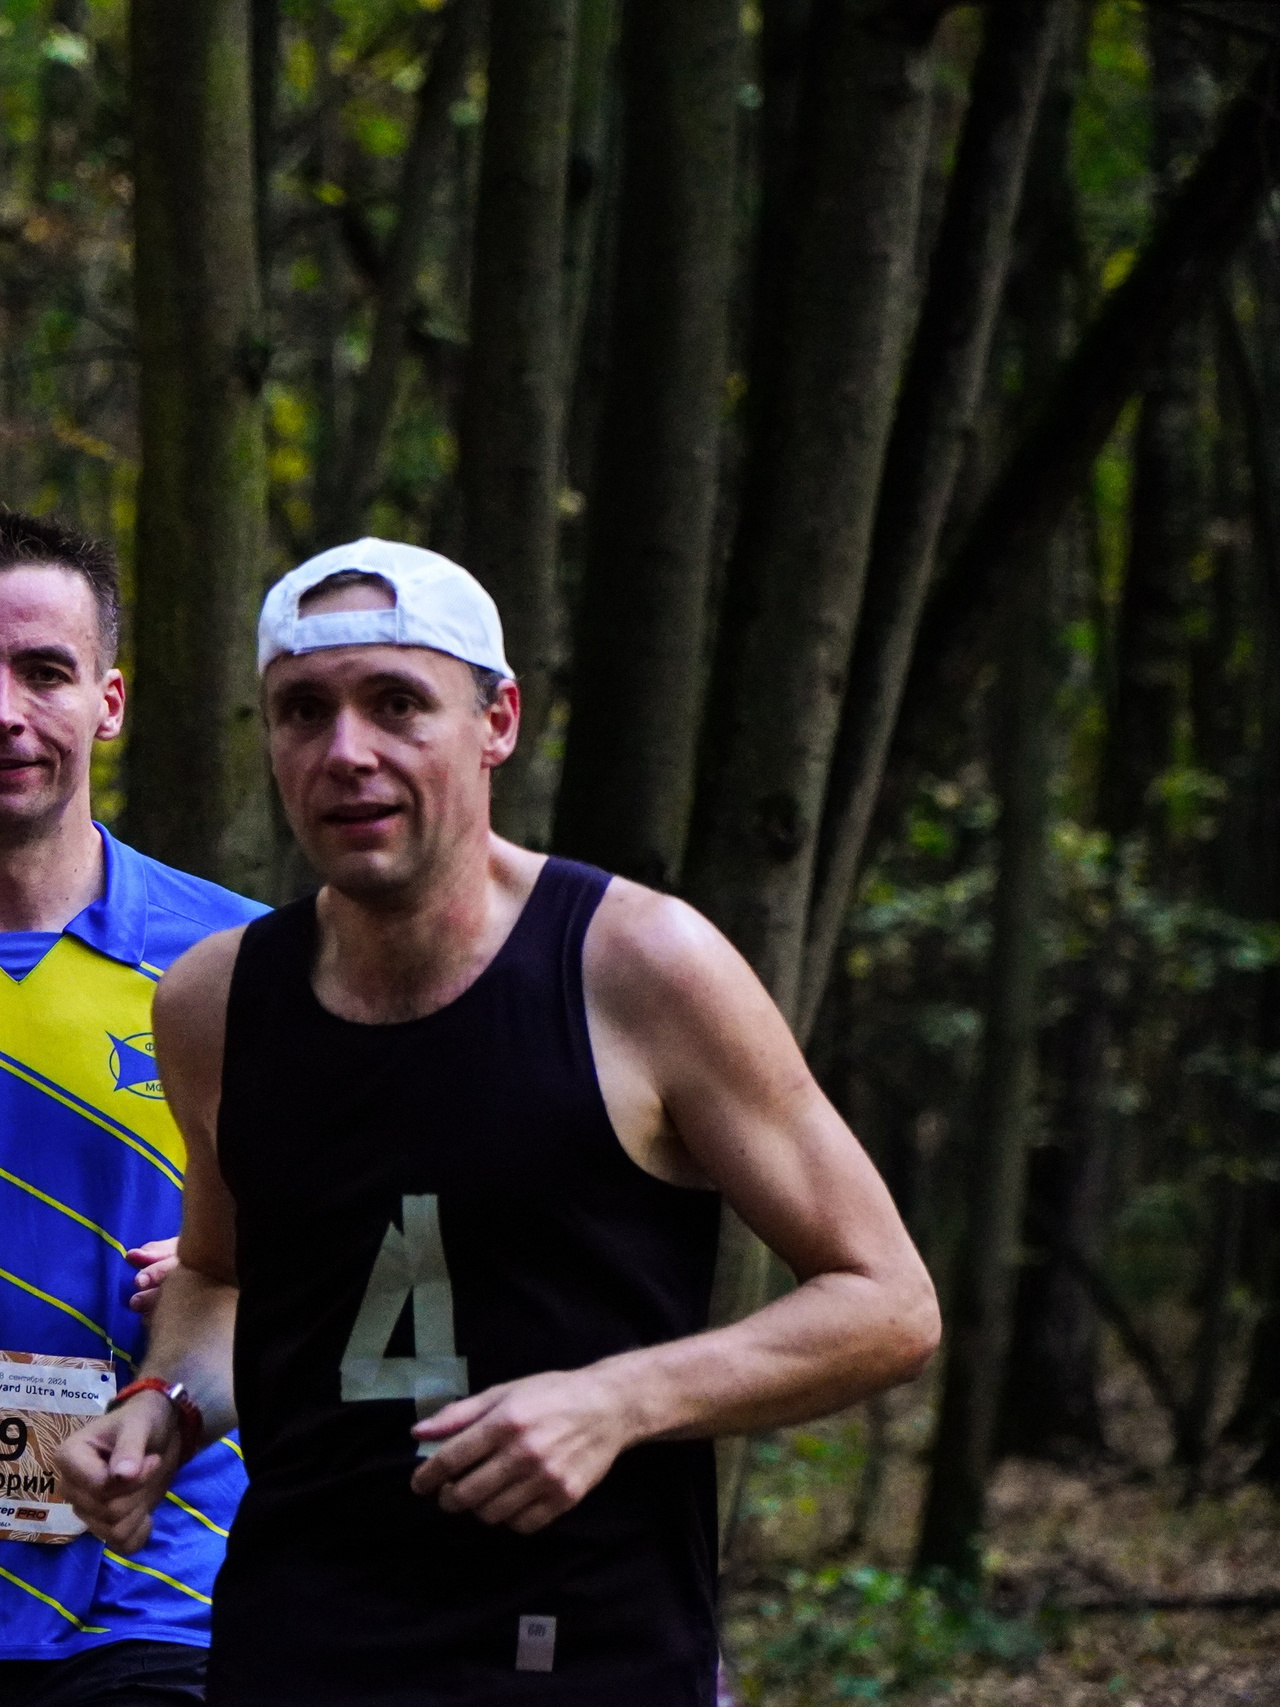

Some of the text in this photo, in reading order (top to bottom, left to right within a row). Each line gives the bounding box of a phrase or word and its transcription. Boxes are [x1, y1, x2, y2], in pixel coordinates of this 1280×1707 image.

[339, 1193, 470, 1459] 4
[47, 1377, 68, 1386] 2024
[25, 1385, 55, 1397] Ultra
[60, 1389, 100, 1401] Moscow
[17, 1508, 48, 1520] PRO
